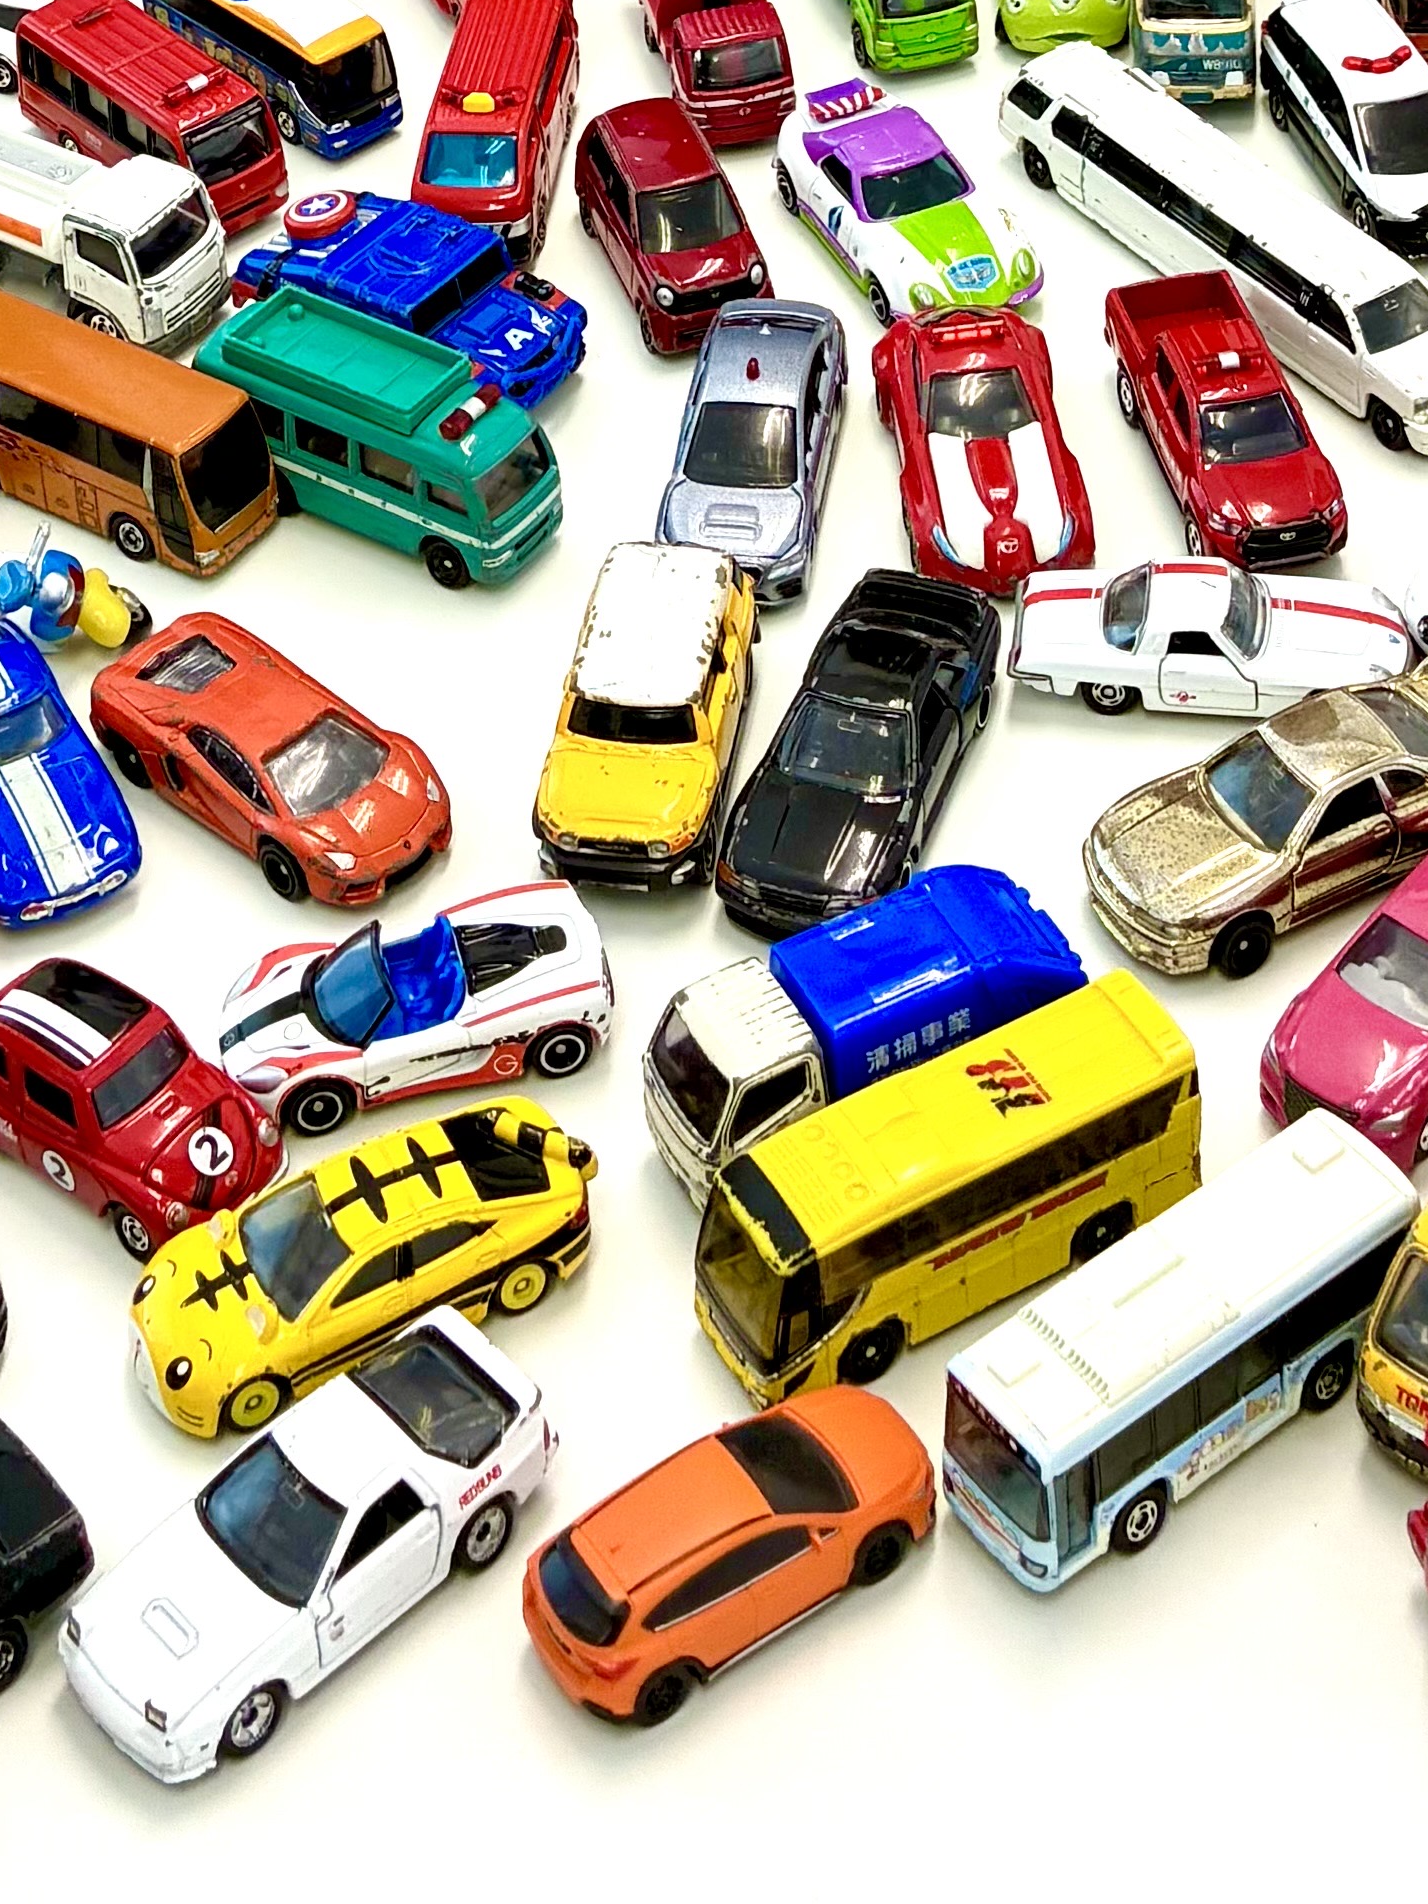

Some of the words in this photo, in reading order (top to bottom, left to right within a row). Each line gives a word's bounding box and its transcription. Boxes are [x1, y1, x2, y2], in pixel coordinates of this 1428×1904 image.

[503, 326, 535, 352] A
[193, 1132, 229, 1172] 2
[51, 1156, 72, 1183] 2
